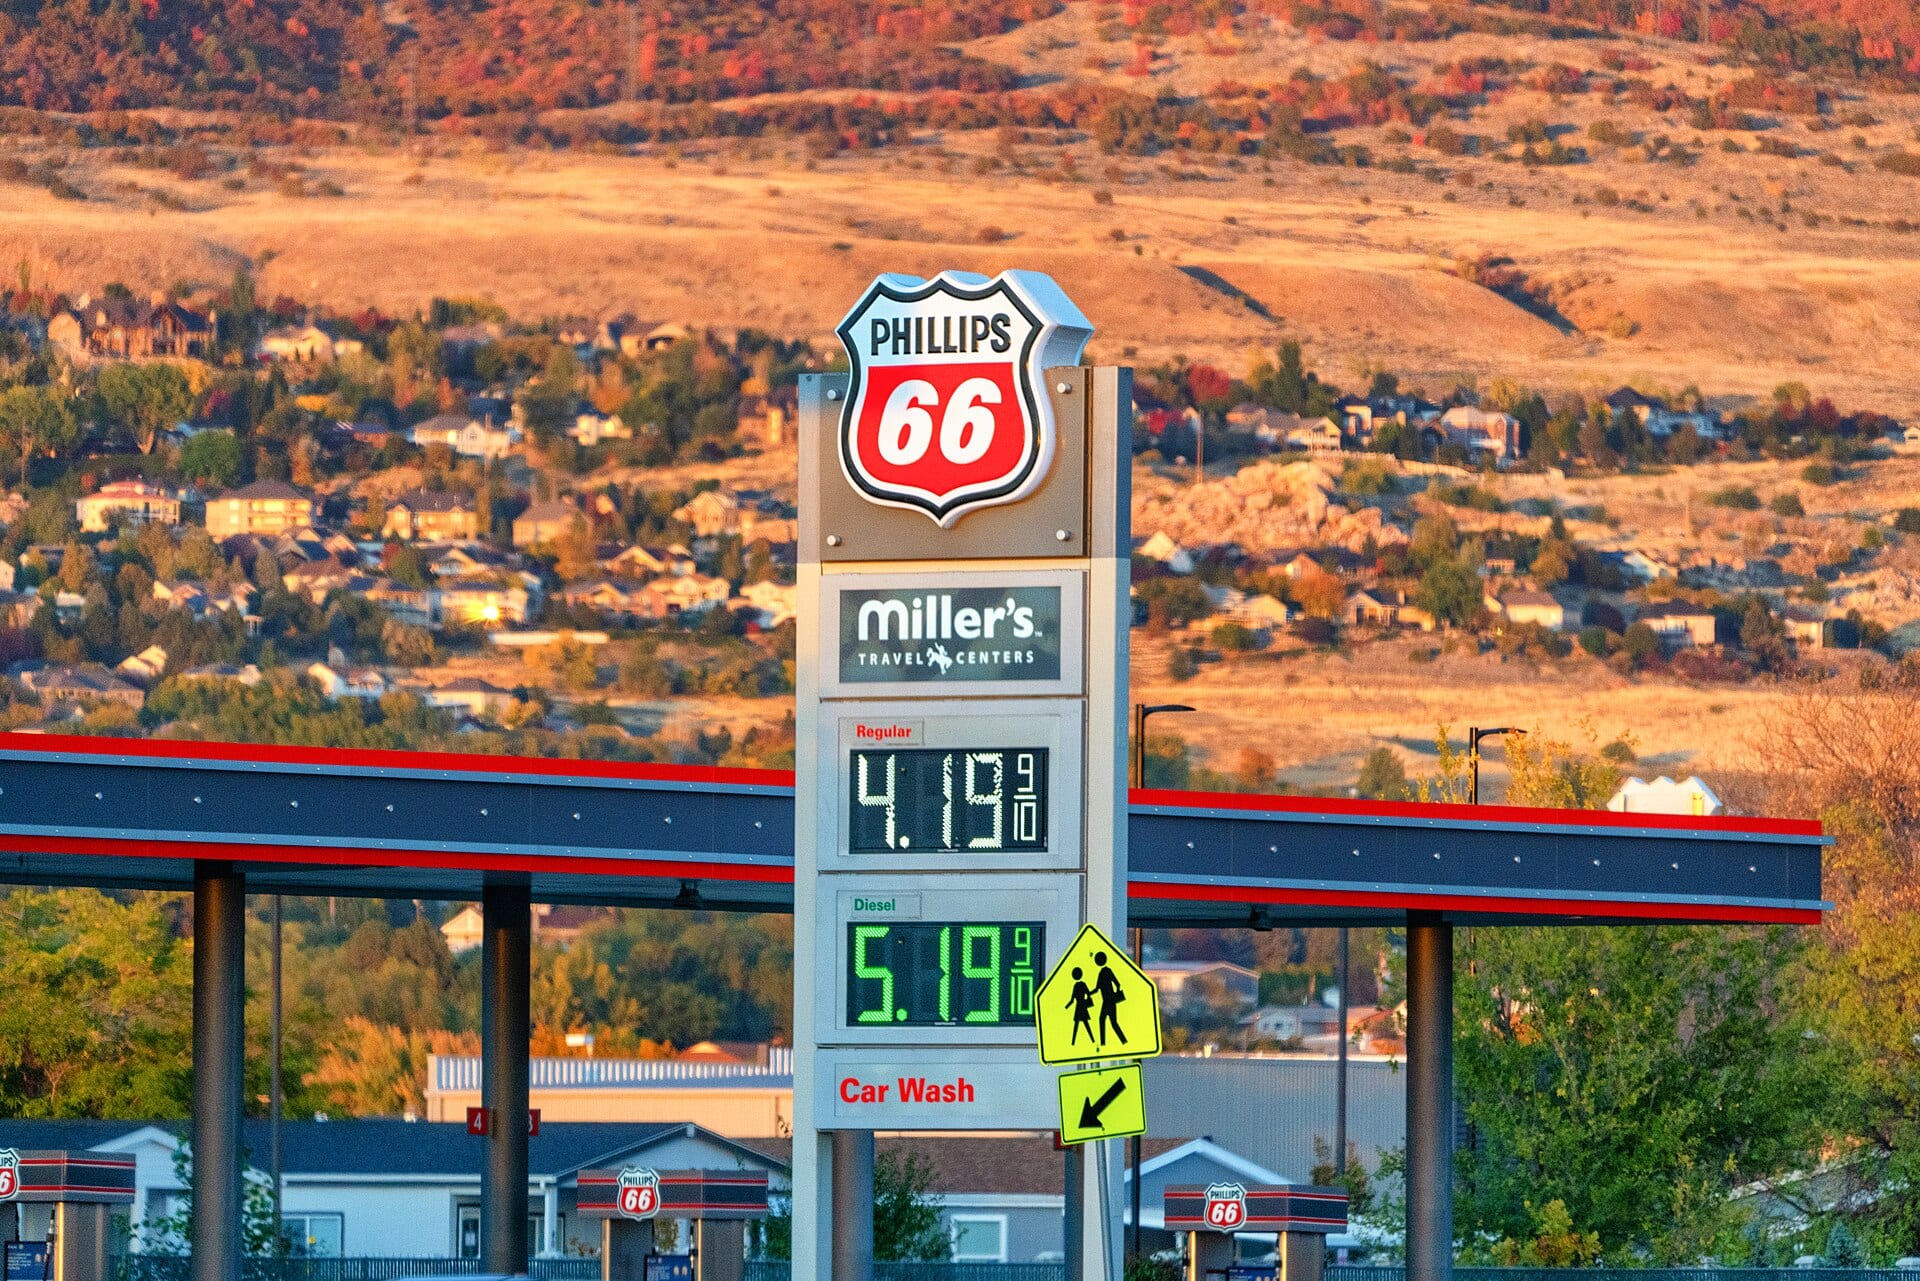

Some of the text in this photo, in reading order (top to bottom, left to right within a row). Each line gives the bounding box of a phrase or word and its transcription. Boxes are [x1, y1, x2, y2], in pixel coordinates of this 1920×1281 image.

[871, 314, 1011, 356] PHILLIPS
[878, 378, 1002, 466] 66
[859, 651, 1034, 666] TRAVEL CENTERS
[856, 724, 912, 741] Regular
[854, 898, 896, 912] Diesel
[840, 1078, 975, 1103] Car Wash
[473, 1112, 482, 1130] 4
[623, 1176, 653, 1185] PHILLIPS
[625, 1189, 651, 1210] 66
[1210, 1190, 1240, 1199] PHILLIPS
[1212, 1203, 1238, 1223] 66
